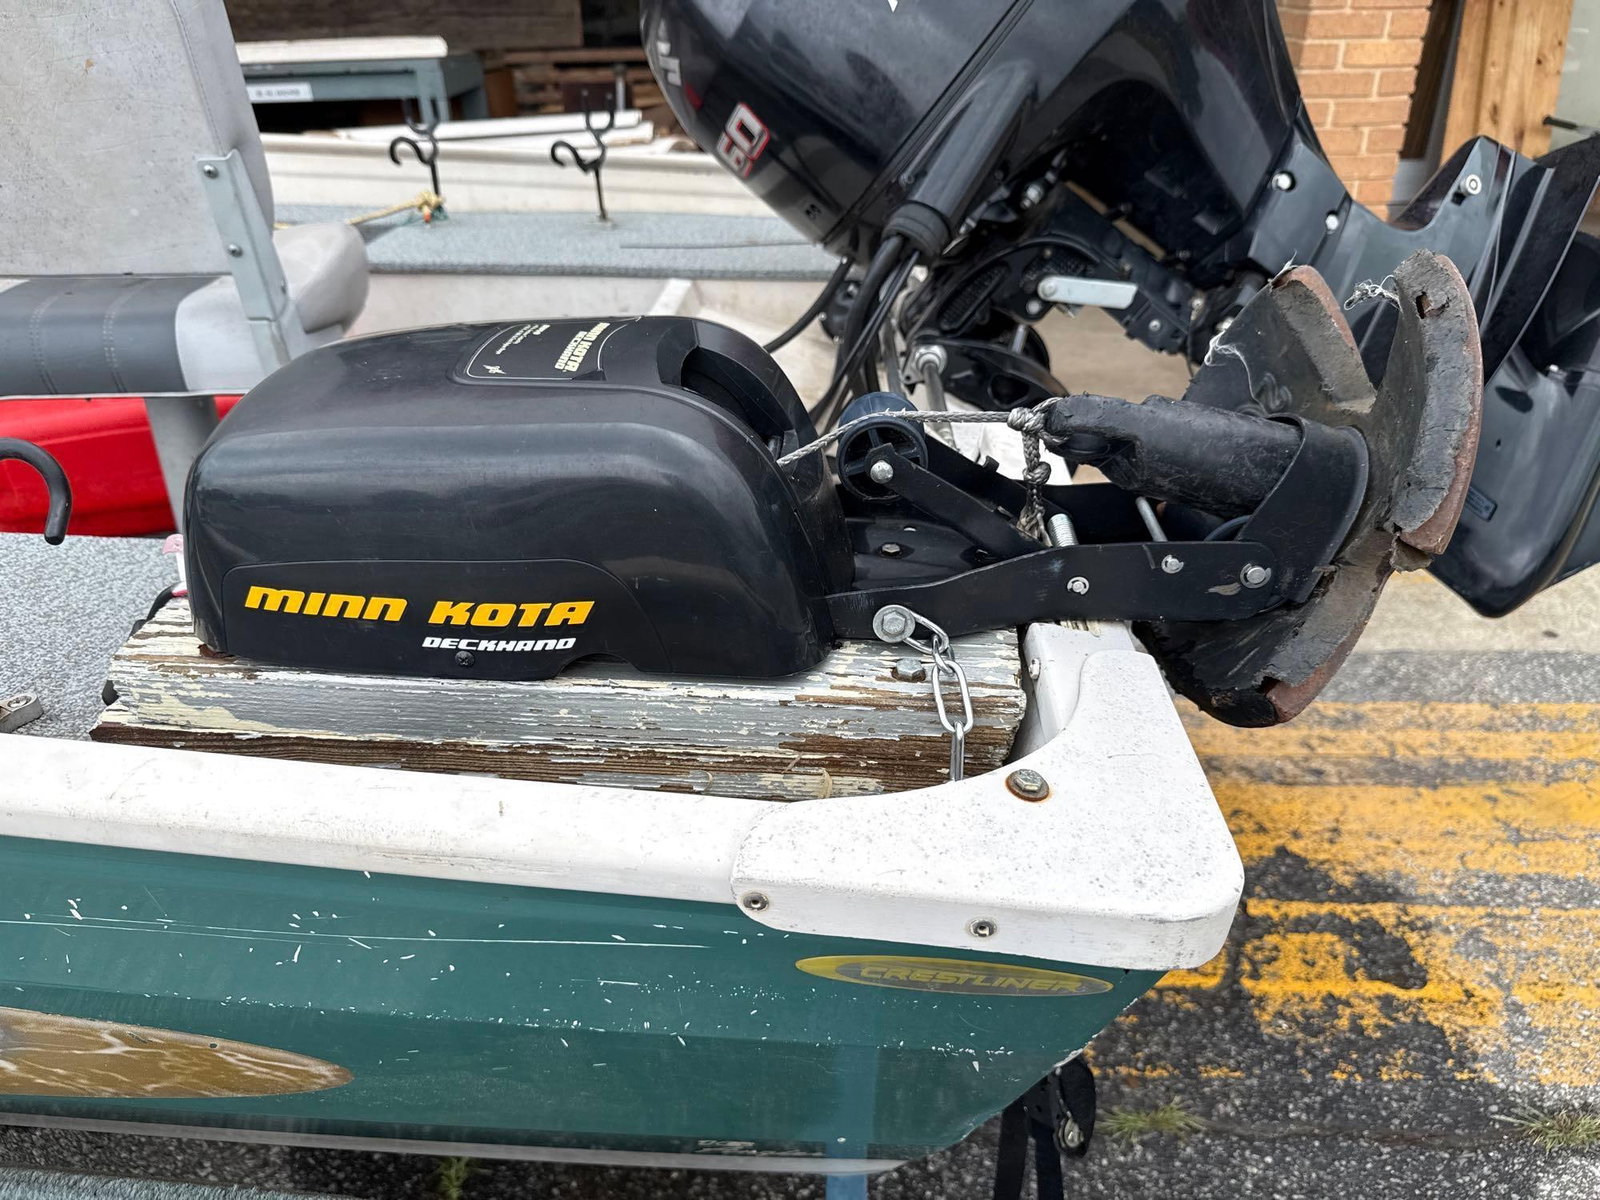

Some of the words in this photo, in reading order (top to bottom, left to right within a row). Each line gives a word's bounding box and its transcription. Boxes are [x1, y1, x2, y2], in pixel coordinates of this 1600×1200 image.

[716, 102, 770, 179] 60
[564, 340, 592, 371] KOTA
[244, 586, 408, 622] MINN
[427, 600, 596, 628] KOTA
[421, 636, 577, 652] DECKHAND
[860, 966, 1083, 992] CRESTLINER
